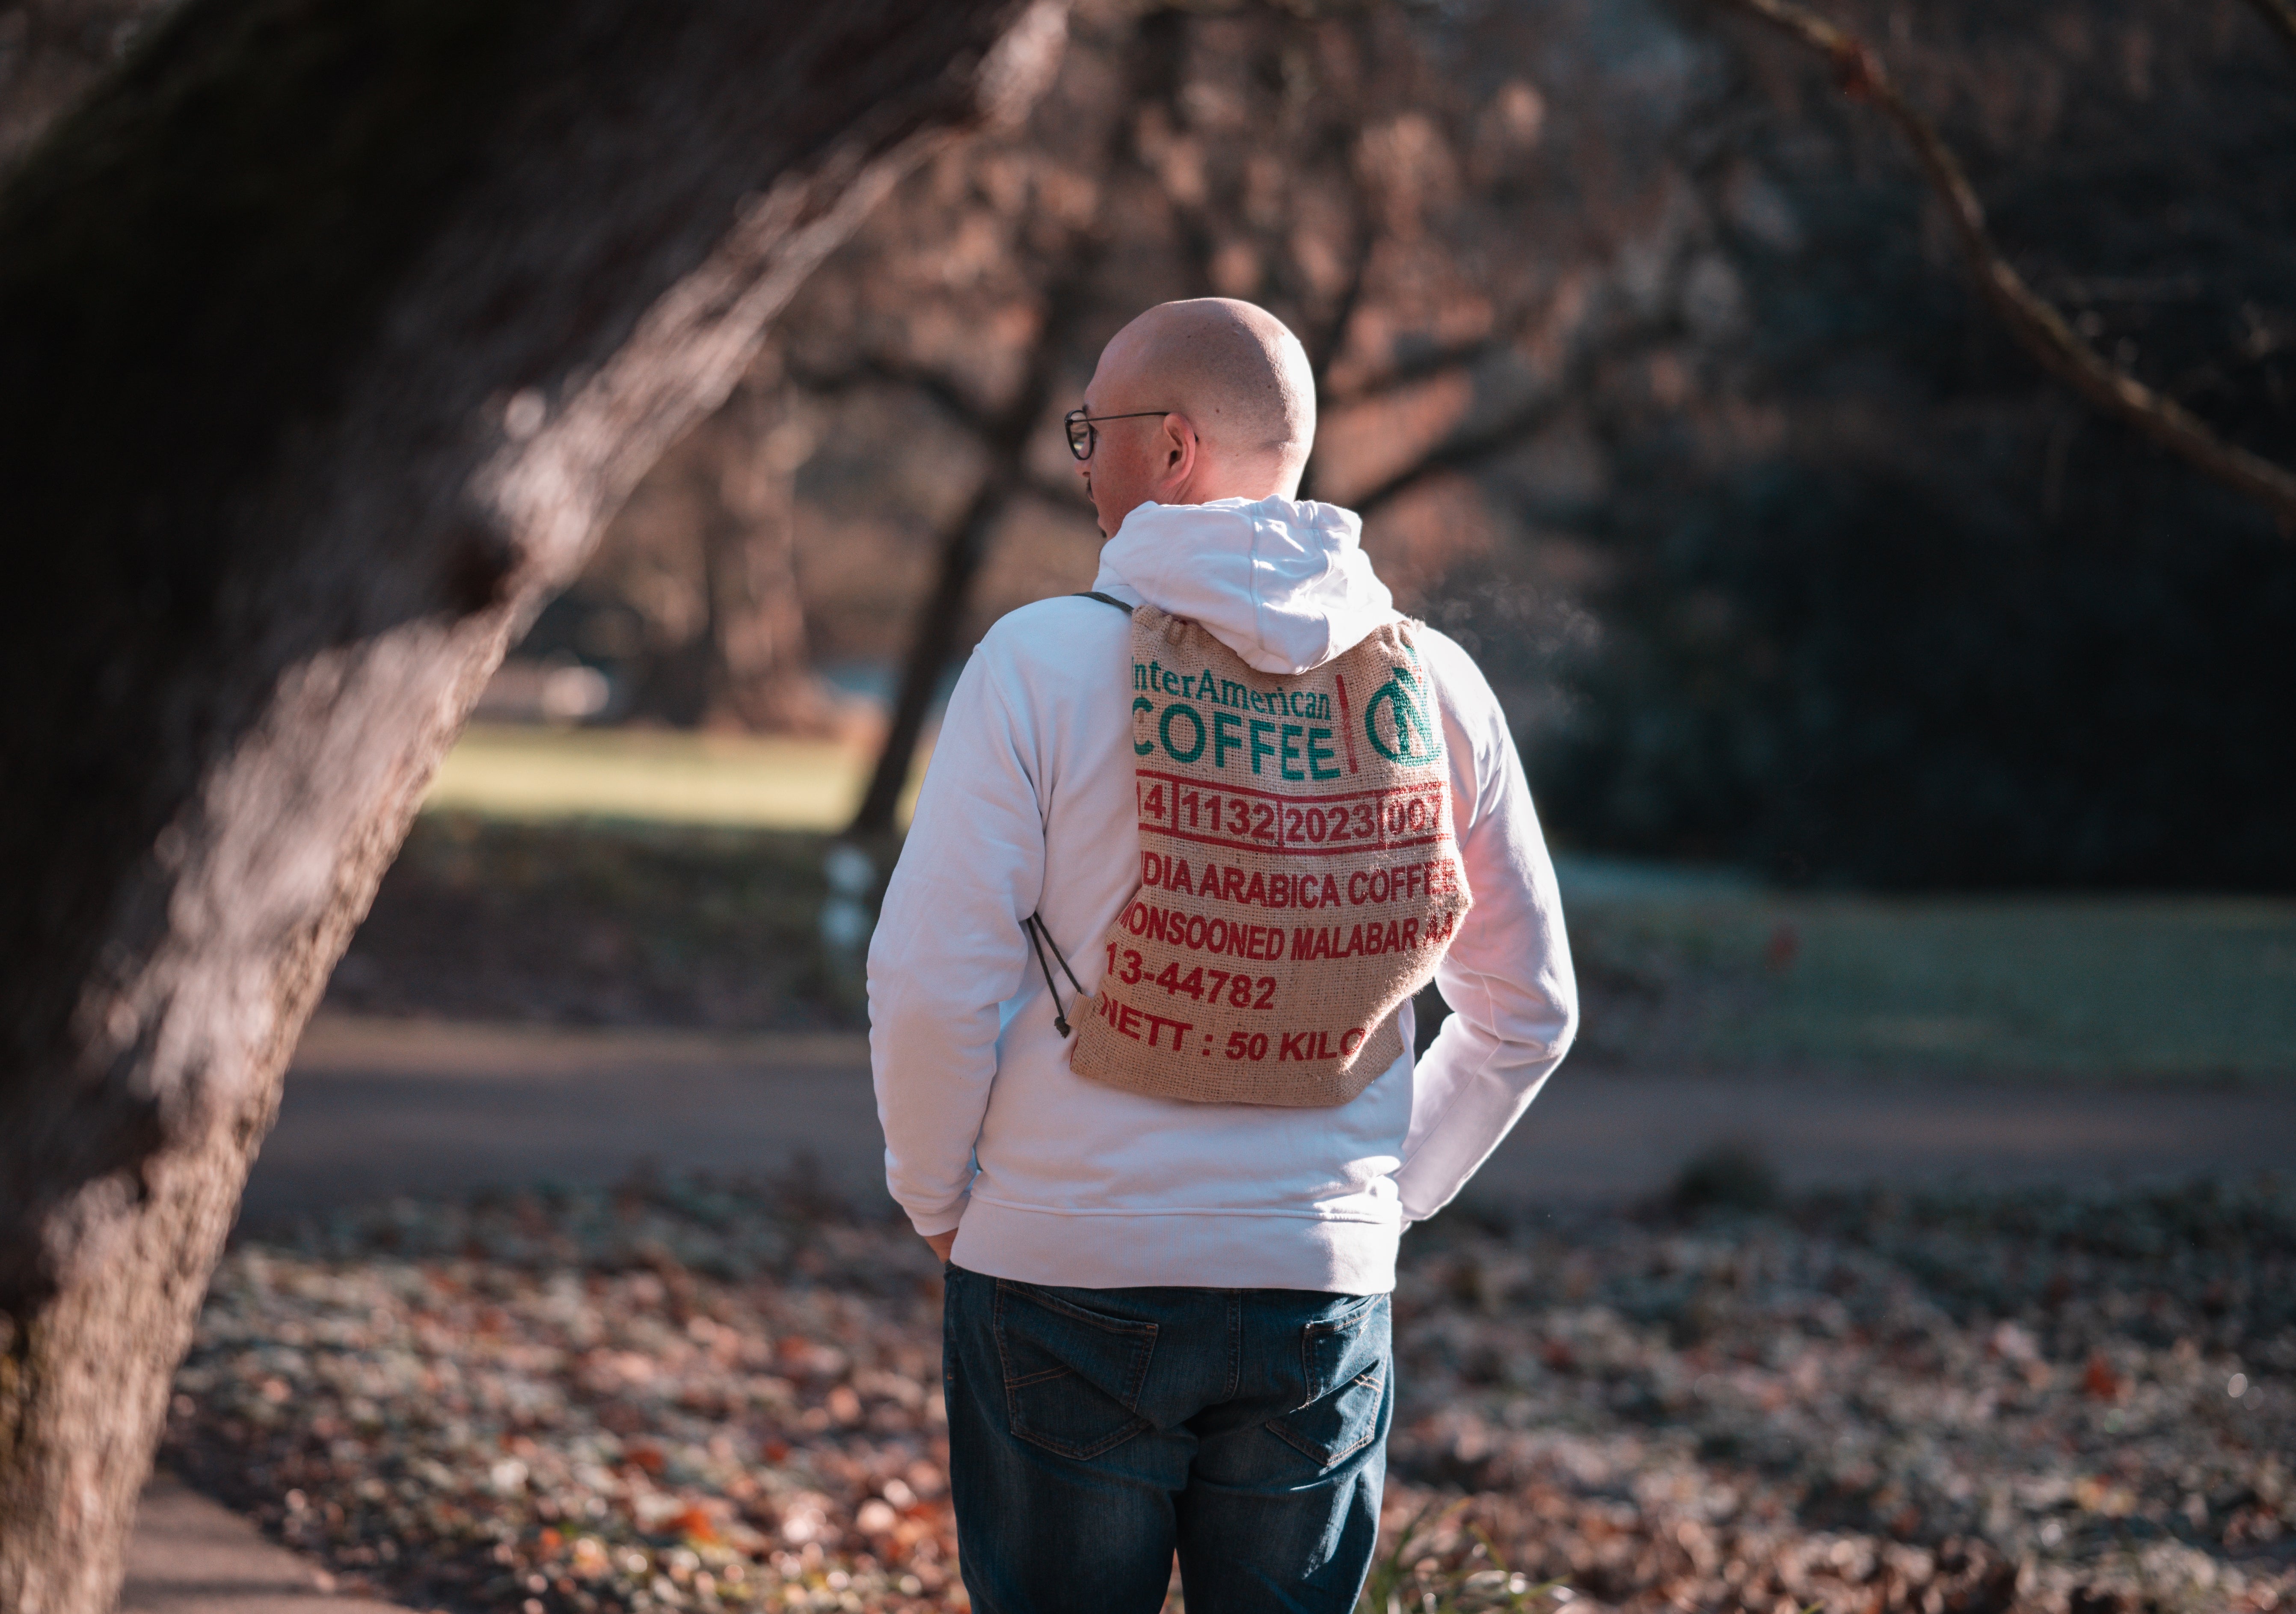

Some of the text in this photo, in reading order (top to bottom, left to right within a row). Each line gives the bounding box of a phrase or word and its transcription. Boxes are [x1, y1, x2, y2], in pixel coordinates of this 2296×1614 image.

[1132, 697, 1341, 781] COFFEE
[1182, 791, 1277, 840] 1132
[1284, 802, 1375, 843] 2023
[1387, 794, 1442, 835] 007
[1140, 850, 1457, 909] DIA ARABICA COFFEE
[1290, 917, 1419, 961] MALABAR
[1106, 941, 1277, 1010] 13-44782
[1100, 990, 1193, 1051] NETT
[1225, 1032, 1268, 1060] 50
